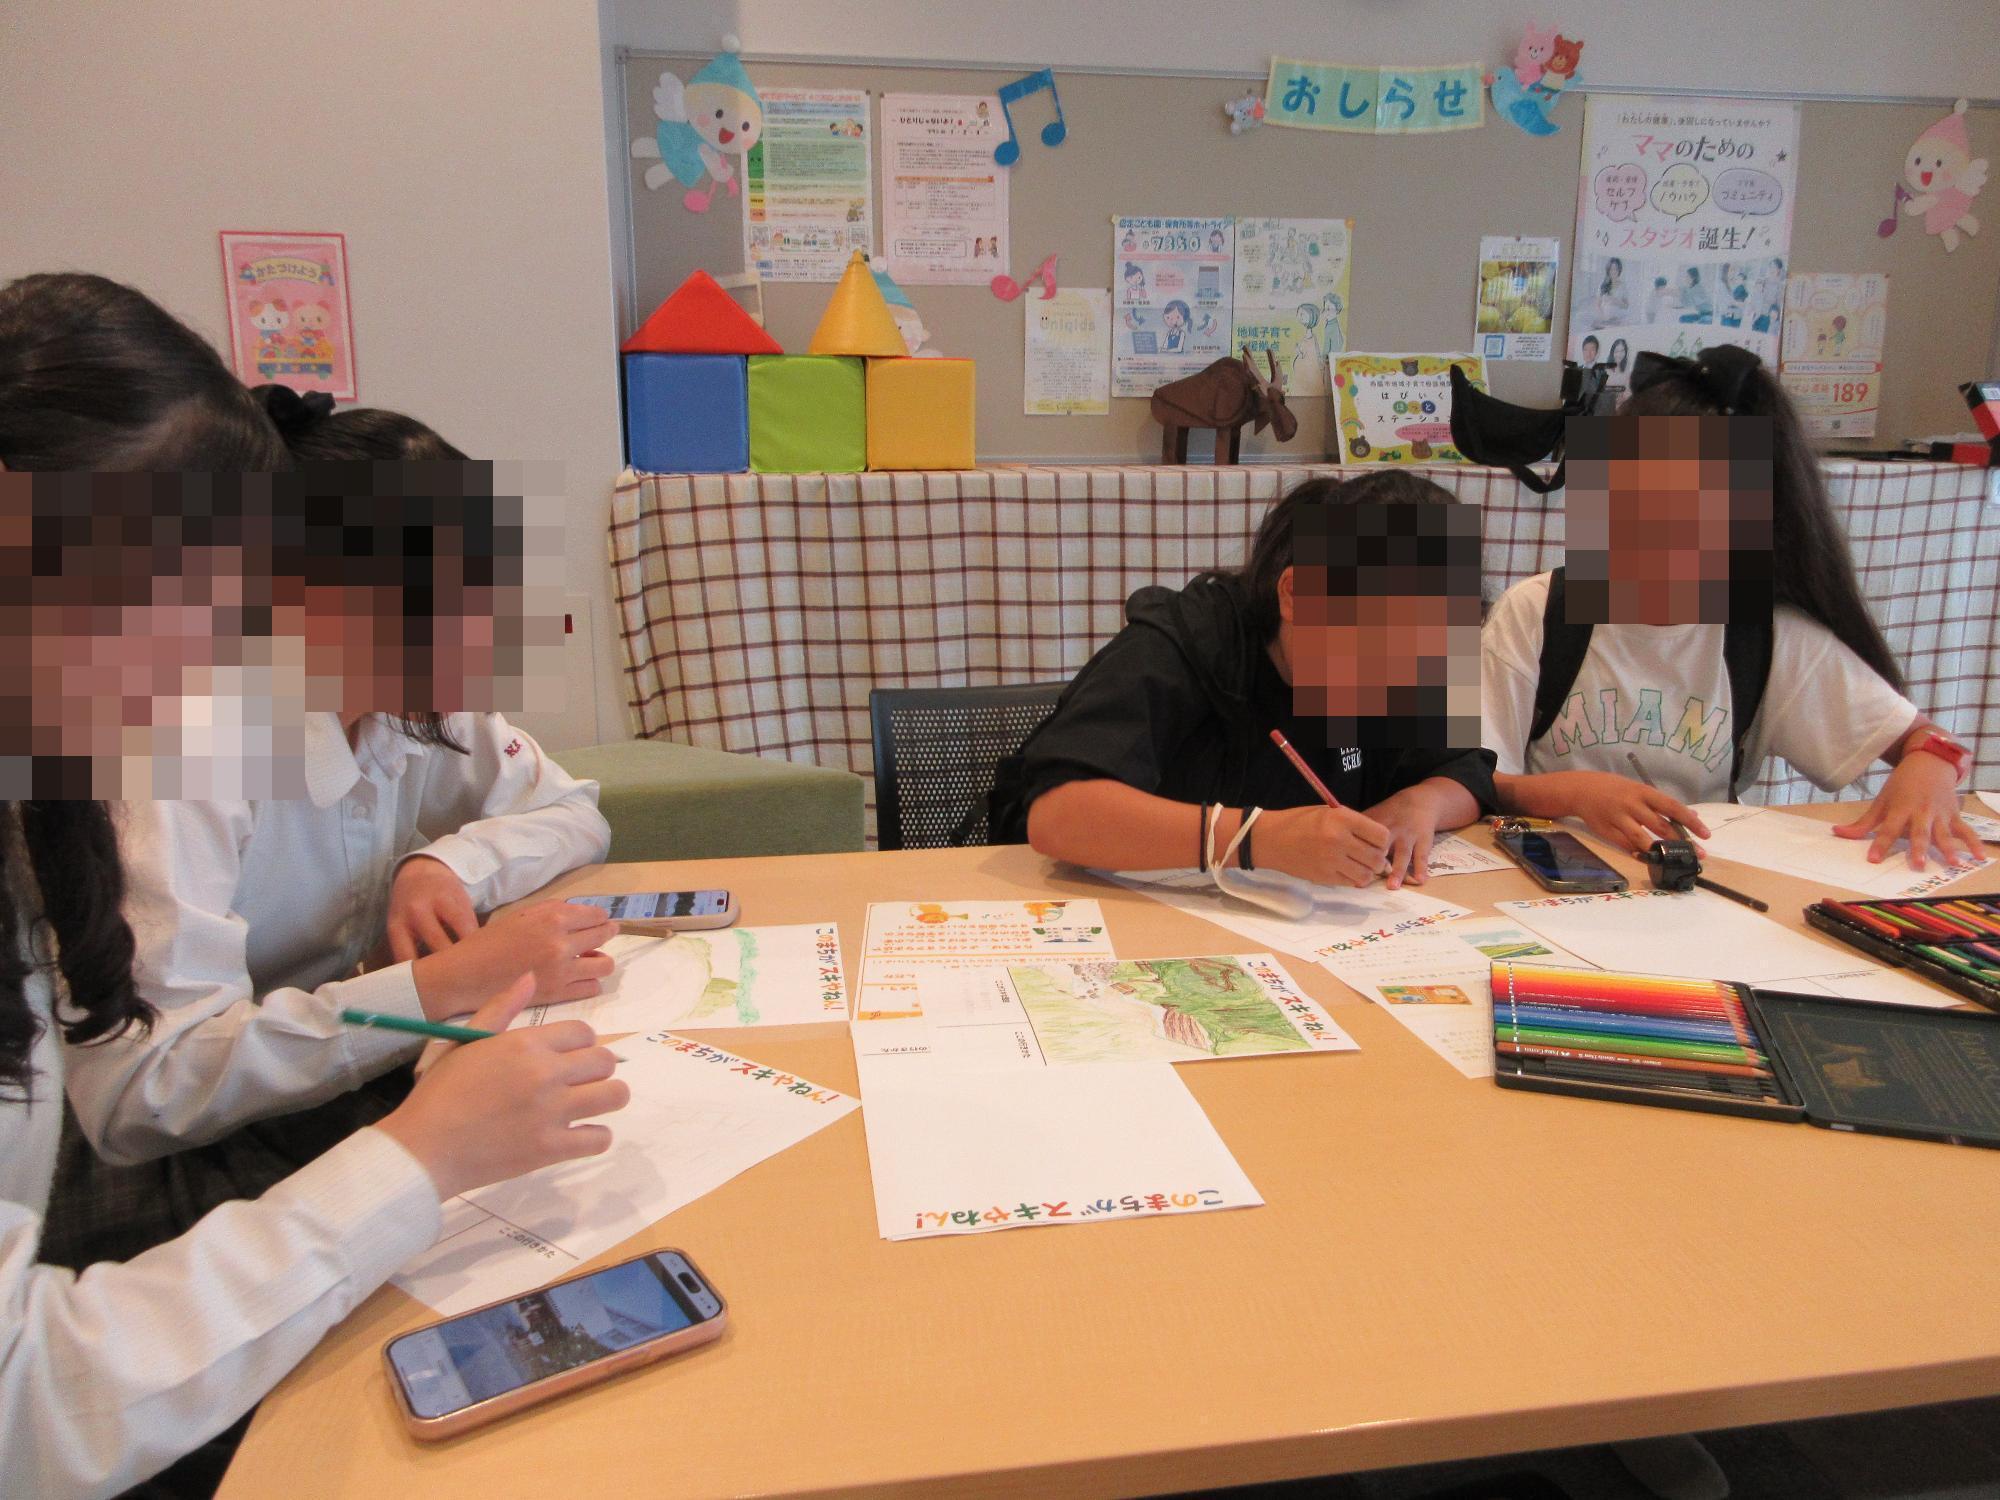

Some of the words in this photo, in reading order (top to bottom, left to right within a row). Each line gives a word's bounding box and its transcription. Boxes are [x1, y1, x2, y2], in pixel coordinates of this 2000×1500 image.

[1281, 74, 1468, 120] おしらせ
[1632, 133, 1754, 163] ママのための
[1618, 225, 1756, 251] スタジオ誕生!
[1832, 382, 1869, 404] 189
[1376, 413, 1451, 424] ステーショ
[815, 927, 845, 1012] このまちがスキやねん!
[1245, 960, 1339, 1042] このまちがスキやねん!
[645, 1033, 839, 1105] このまちがスキやねん!
[914, 1188, 1224, 1231] このまちがスキやねん!
